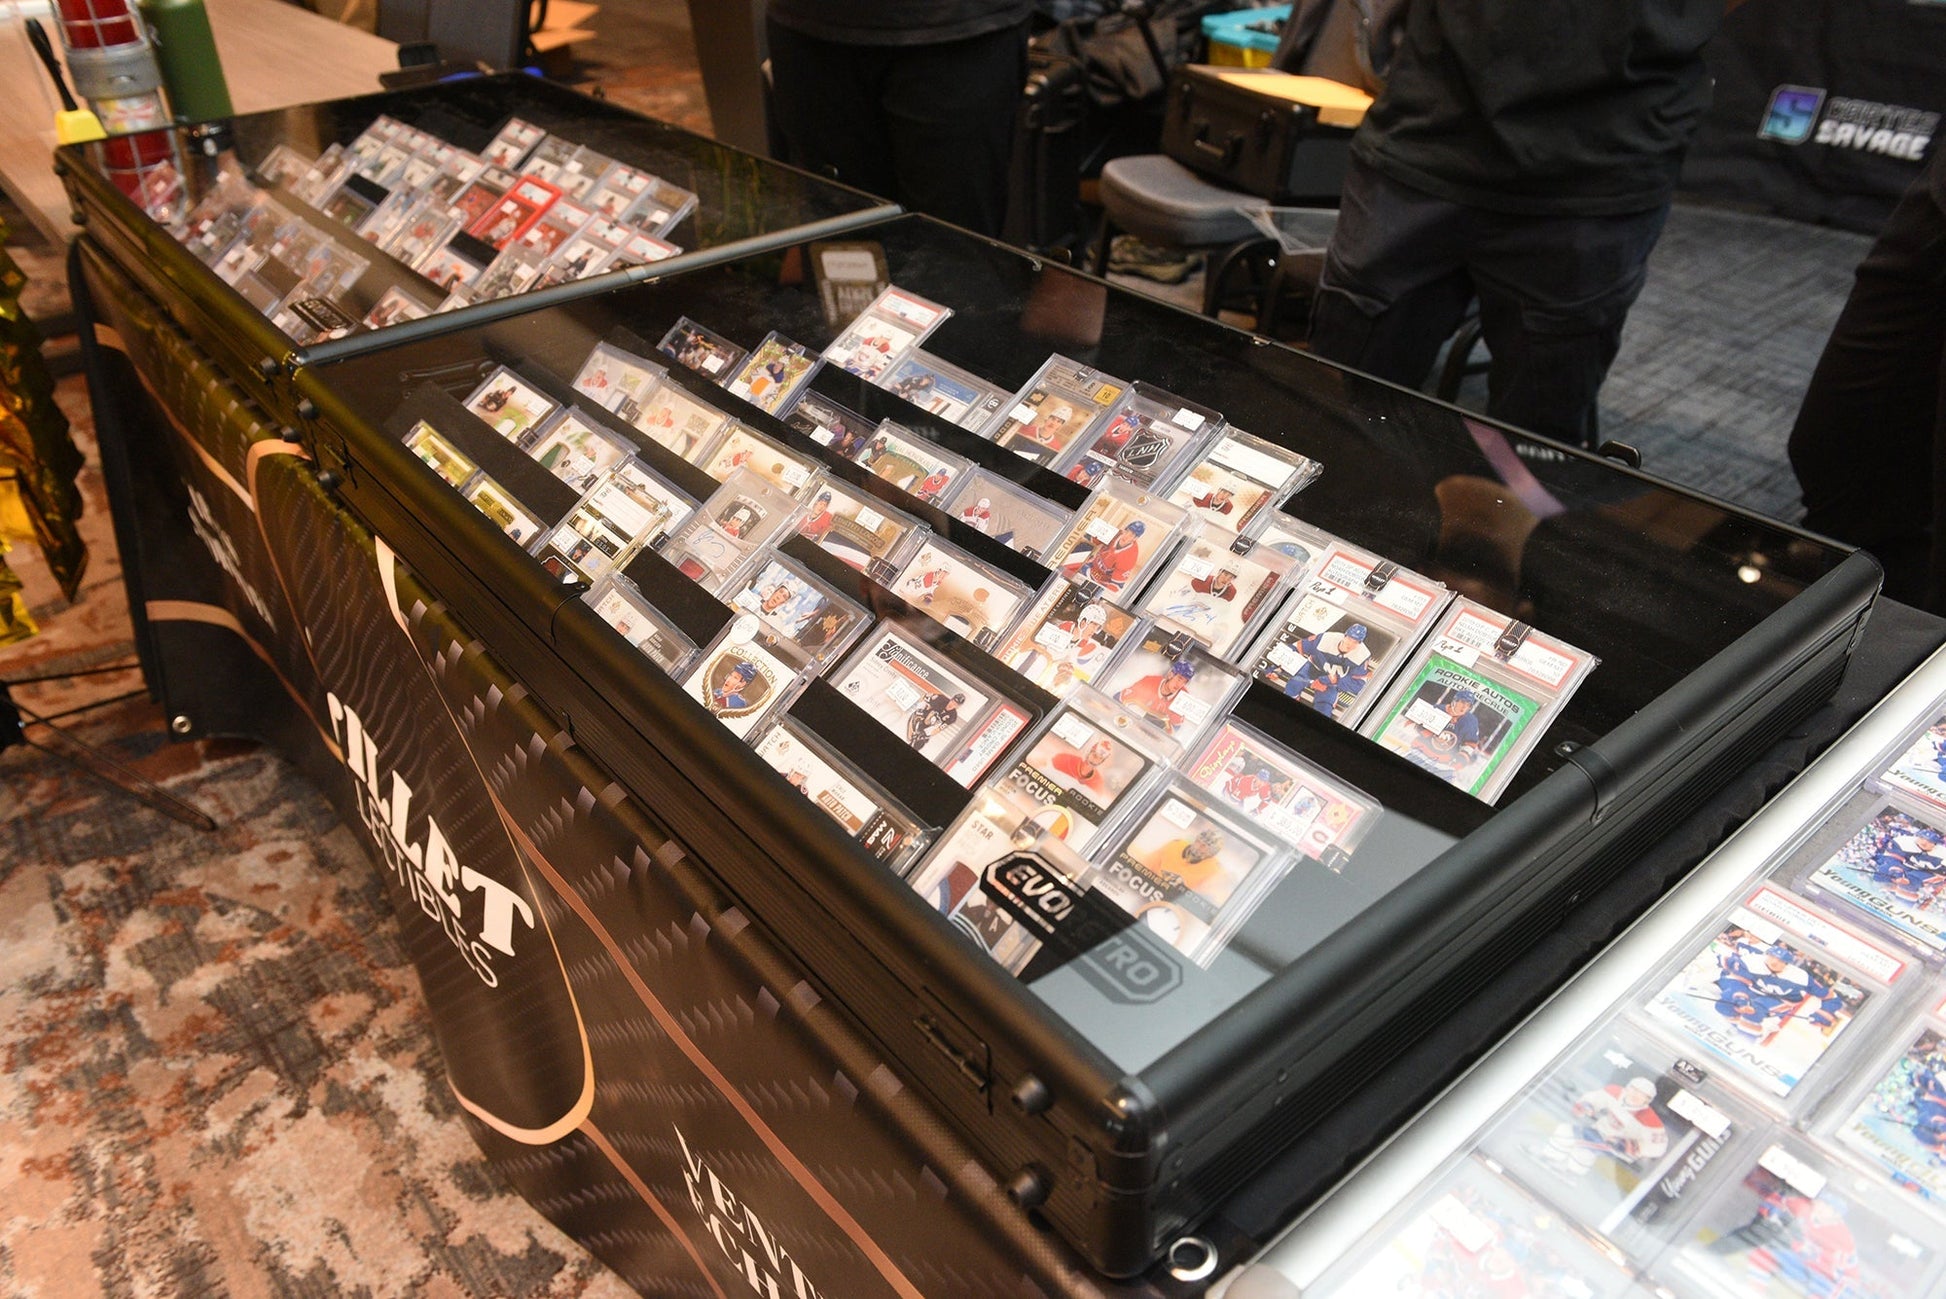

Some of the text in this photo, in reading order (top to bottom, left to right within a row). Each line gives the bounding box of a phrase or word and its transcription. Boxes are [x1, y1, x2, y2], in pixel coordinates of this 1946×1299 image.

[1814, 120, 1931, 161] SAVAGE
[1295, 599, 1314, 624] WATCH
[730, 646, 778, 684] COLLECTION
[1435, 668, 1522, 714] ROOKIE AUTOS
[1009, 768, 1056, 805] FOCUS
[1019, 762, 1063, 796] PREMIER
[819, 791, 853, 822] AUTO PATCH
[1069, 790, 1103, 816] ROOKIE
[971, 820, 993, 840] STAR
[354, 779, 498, 988] LECTIBLES
[1109, 861, 1165, 902] FOCUS
[1119, 853, 1171, 890] PREMIER
